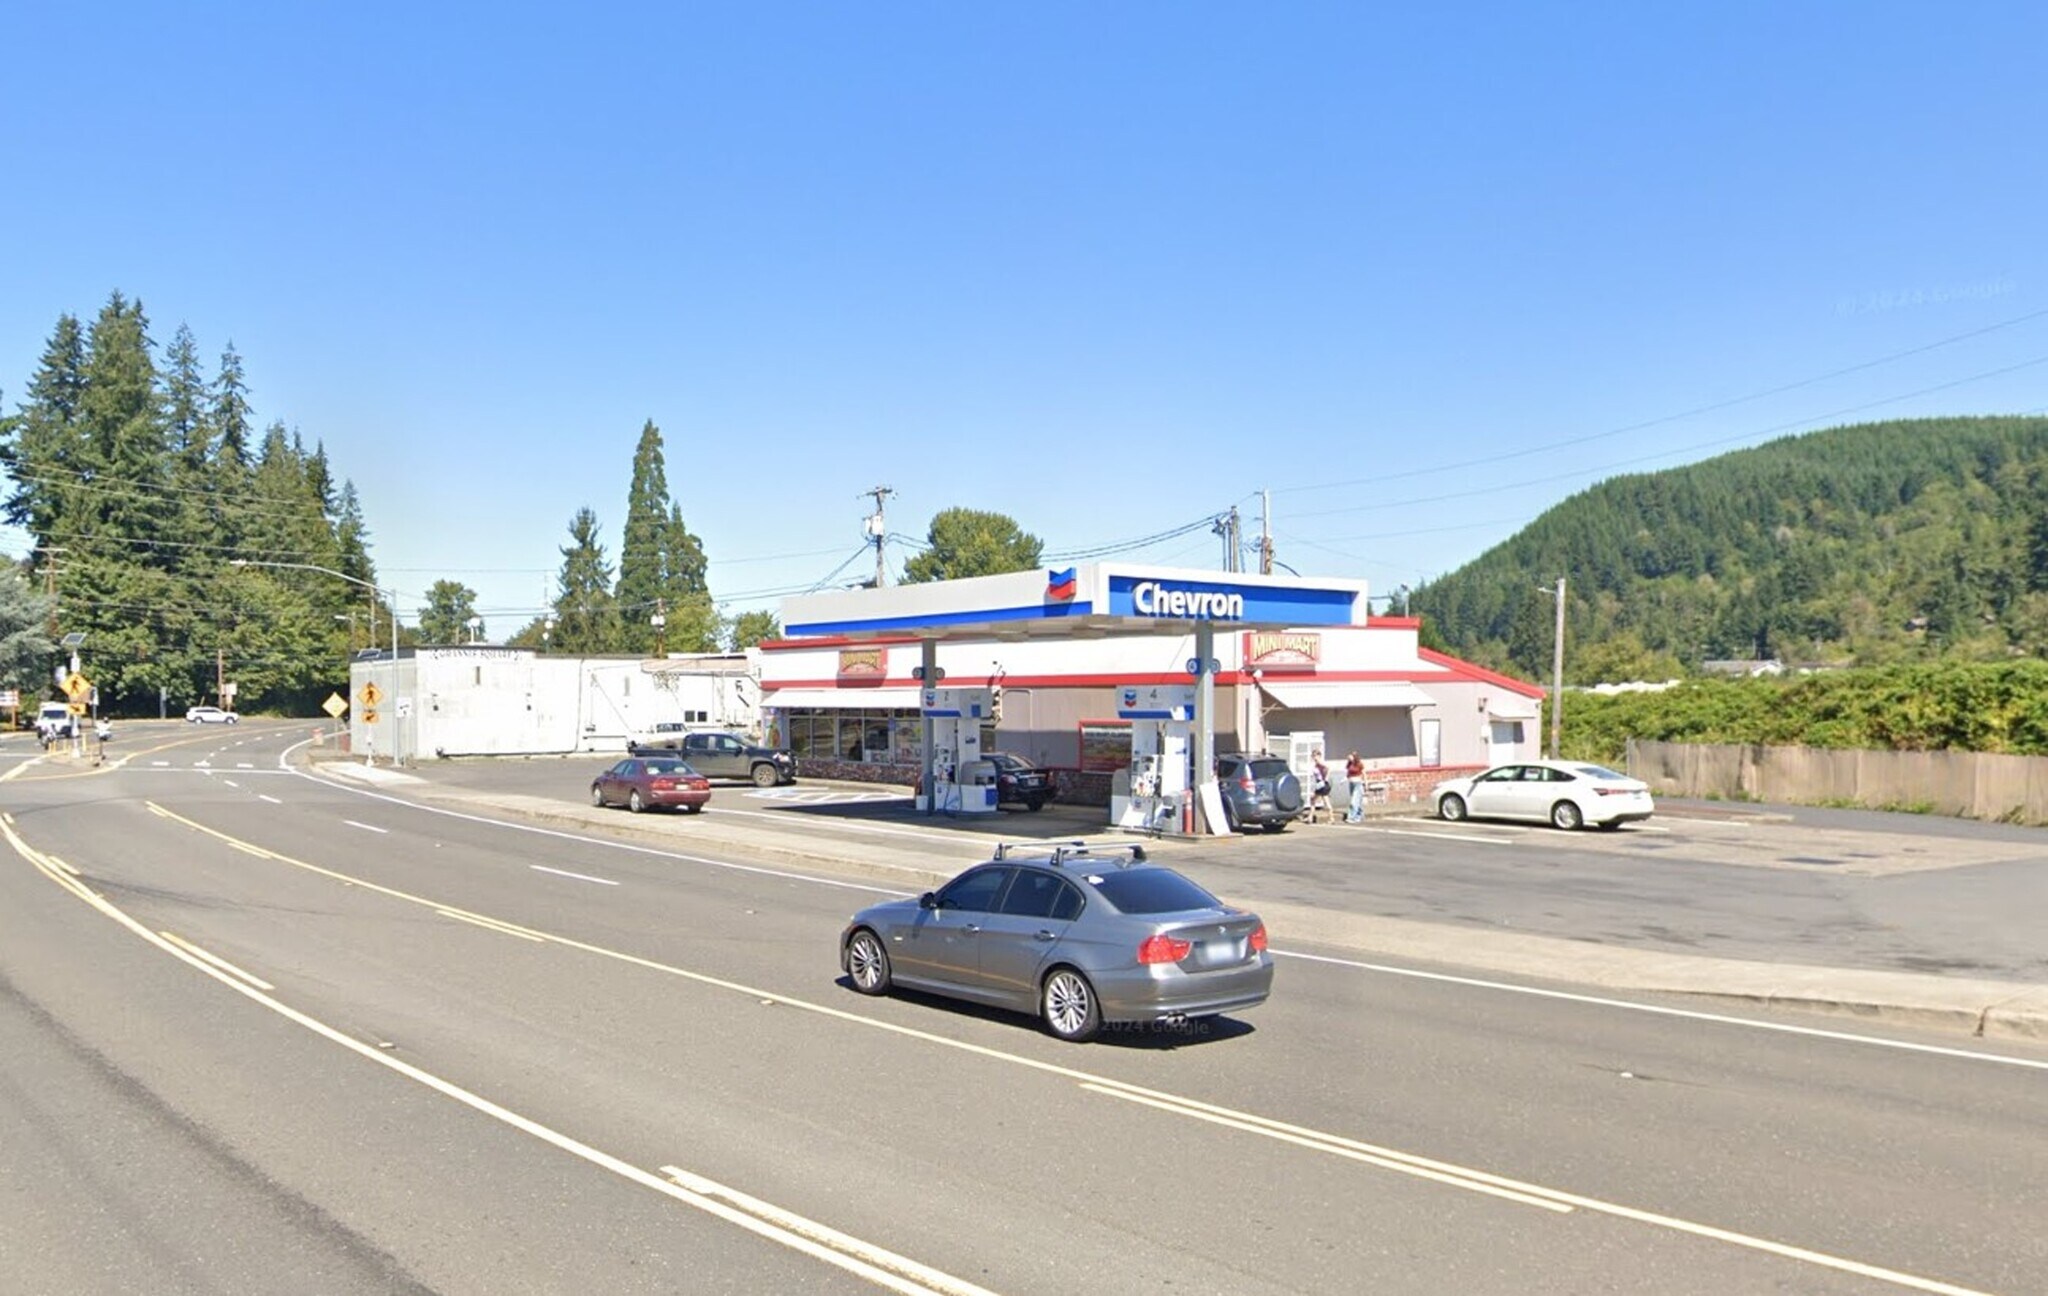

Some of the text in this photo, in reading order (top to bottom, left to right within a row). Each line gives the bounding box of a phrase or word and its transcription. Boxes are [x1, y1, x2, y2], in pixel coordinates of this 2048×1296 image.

[1134, 581, 1244, 618] Chevron
[1252, 633, 1317, 658] MINI MART
